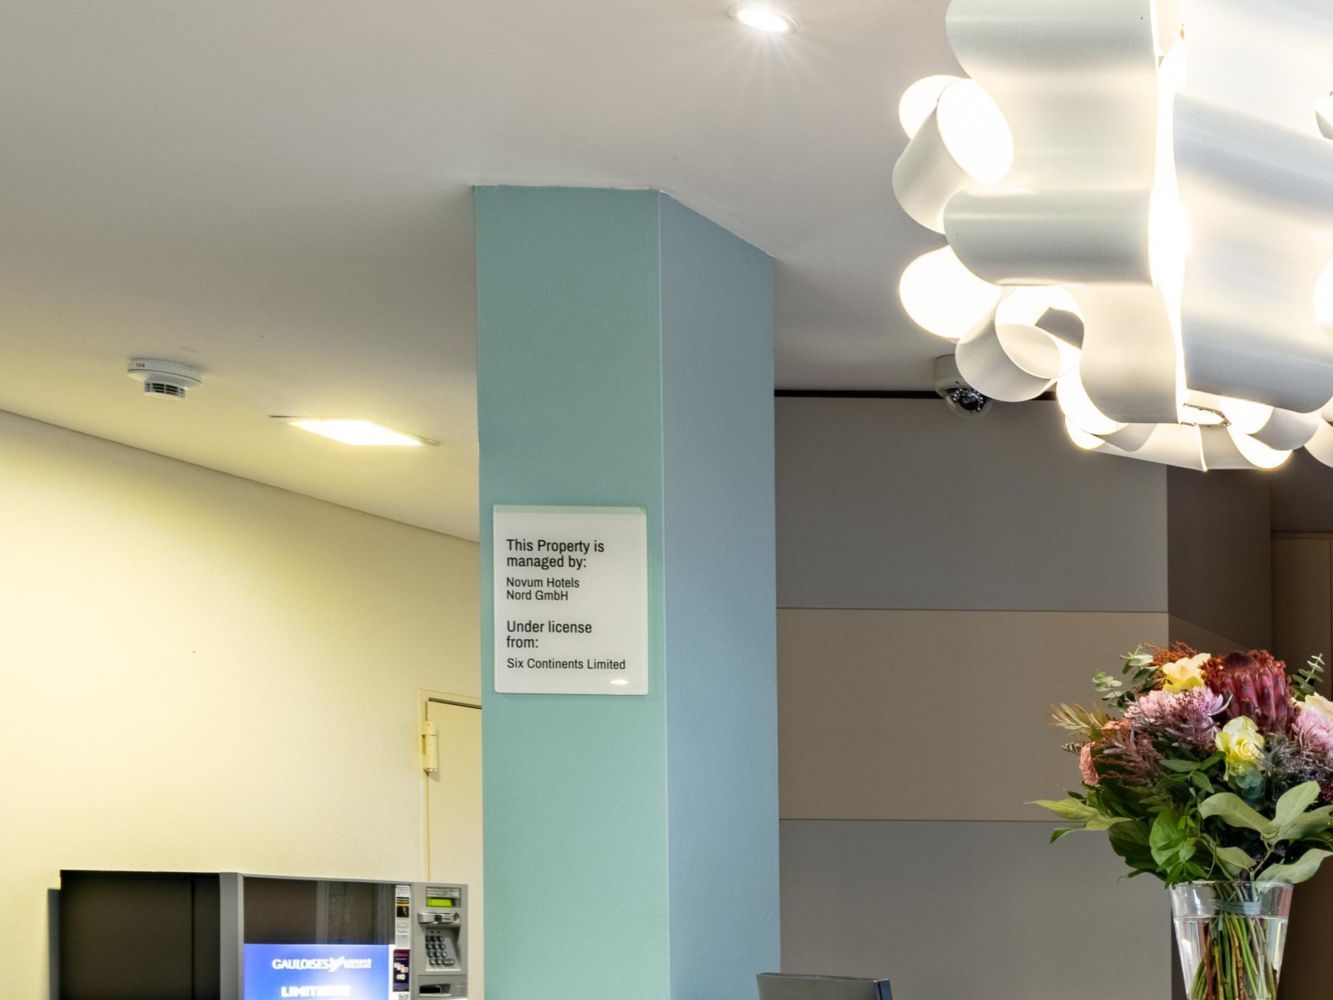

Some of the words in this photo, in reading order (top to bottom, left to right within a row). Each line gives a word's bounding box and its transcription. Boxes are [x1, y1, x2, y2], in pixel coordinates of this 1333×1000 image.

[506, 538, 533, 552] This
[537, 539, 590, 555] Property
[594, 540, 605, 552] is
[507, 555, 564, 570] managed
[568, 555, 587, 570] by:
[506, 577, 543, 588] Novum
[547, 578, 580, 588] Hotels
[506, 590, 532, 600] Nord
[535, 590, 568, 601] GmbH
[506, 620, 544, 633] Under
[548, 620, 592, 633] license
[506, 636, 539, 648] from:
[507, 658, 524, 669] Six
[527, 658, 584, 669] Continents
[587, 659, 626, 670] Limited
[272, 958, 330, 970] GAULOISES
